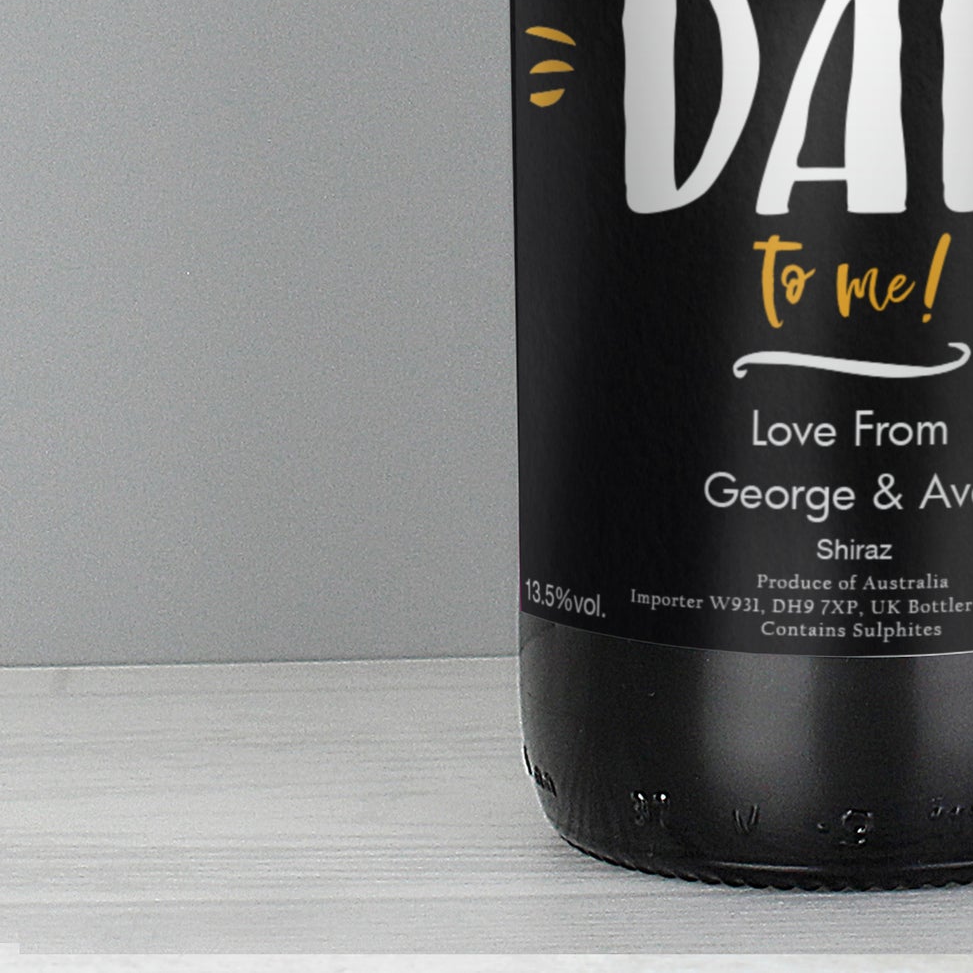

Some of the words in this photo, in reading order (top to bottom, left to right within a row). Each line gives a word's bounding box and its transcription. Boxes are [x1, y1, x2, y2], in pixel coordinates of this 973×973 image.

[752, 233, 816, 330] to
[836, 232, 952, 323] me!
[752, 409, 837, 447] Love
[854, 409, 949, 447] From
[703, 471, 856, 523] George
[872, 473, 904, 511] &
[816, 538, 893, 561] Shiraz
[524, 578, 606, 618] 13.5%vol.
[757, 574, 832, 590] Produce
[838, 574, 858, 590] of
[862, 573, 949, 590] Australia
[630, 588, 704, 611] Importer
[709, 594, 766, 615] W931,
[771, 598, 815, 615] DH9
[820, 599, 864, 617] 7XP,
[870, 599, 901, 615] UK
[908, 597, 973, 615] Bottler
[760, 620, 846, 638] Contains
[852, 621, 943, 643] Sulphites
